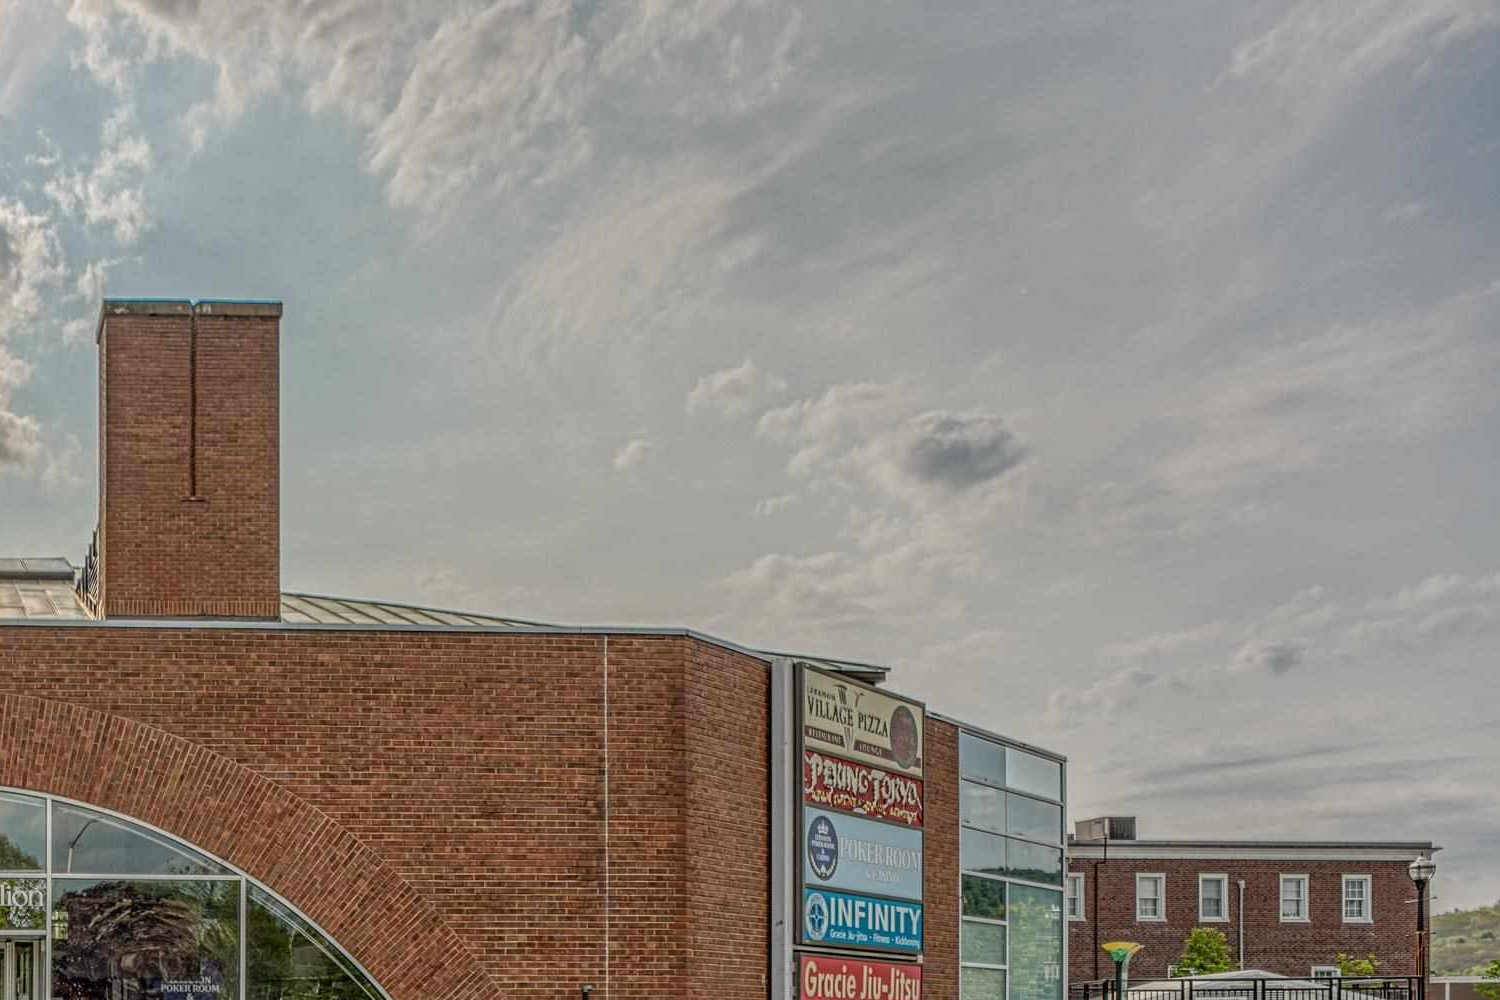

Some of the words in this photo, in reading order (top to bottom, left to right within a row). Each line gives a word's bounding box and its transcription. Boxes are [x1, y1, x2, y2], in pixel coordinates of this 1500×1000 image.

[807, 695, 854, 727] VILLAGE
[858, 711, 889, 737] PIZZA
[804, 753, 869, 797] PEKING
[868, 769, 923, 811] TOKYO
[839, 836, 884, 866] POKER
[830, 896, 921, 935] INFINITY
[160, 983, 192, 993] POKER
[193, 984, 220, 993] ROOM
[186, 993, 194, 1000] &
[804, 961, 857, 998] Gracie
